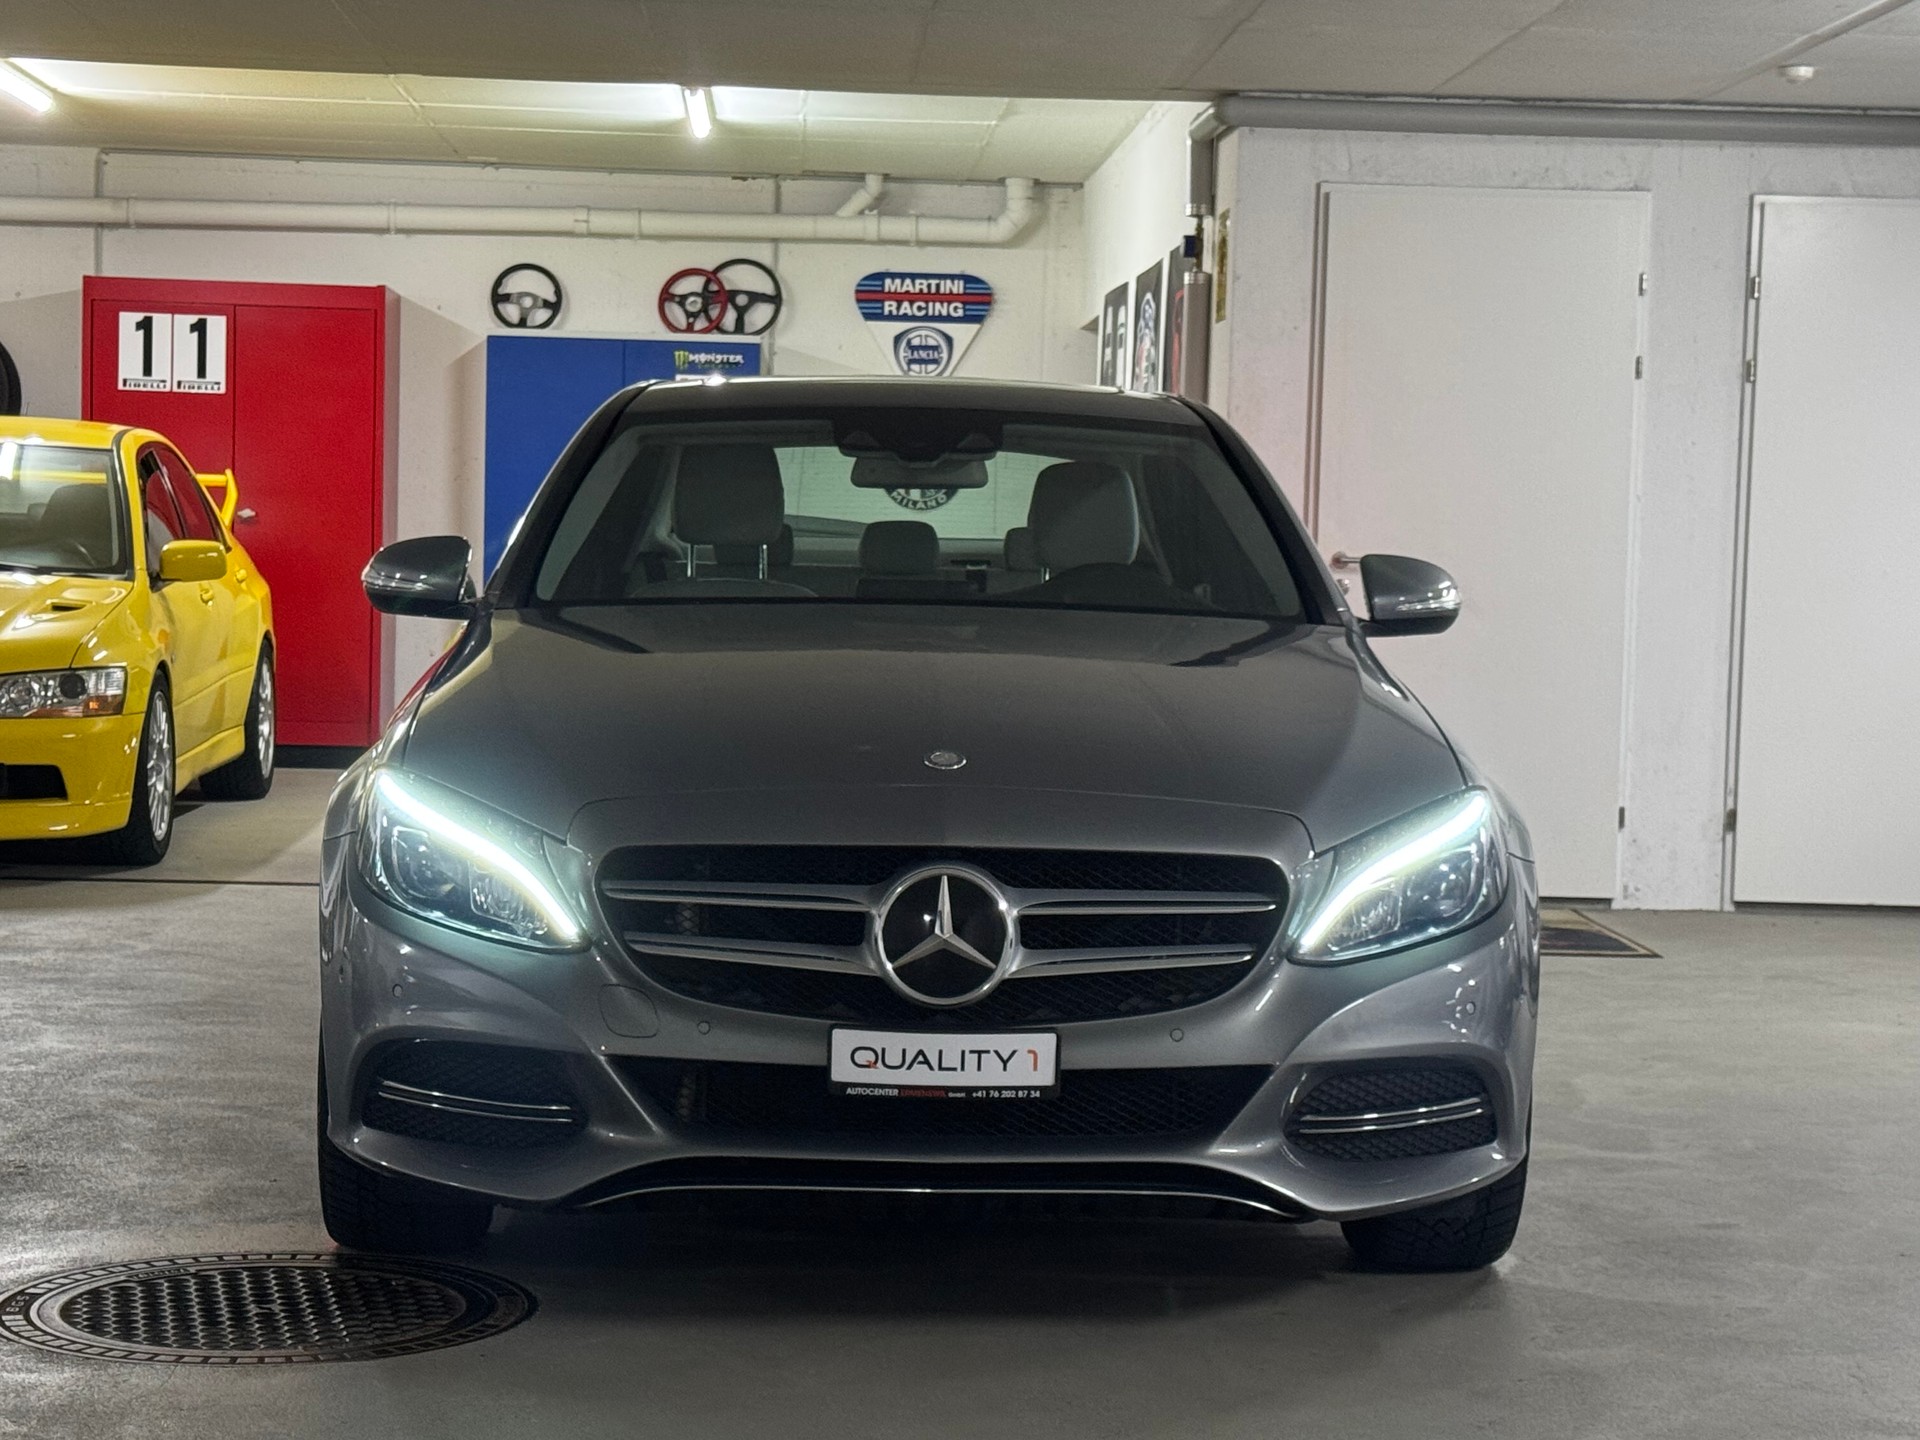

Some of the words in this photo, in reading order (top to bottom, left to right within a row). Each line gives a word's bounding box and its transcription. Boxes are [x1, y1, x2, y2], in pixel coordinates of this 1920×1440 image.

[884, 278, 964, 294] MARTINI
[883, 301, 964, 317] RACING
[689, 352, 744, 364] MONSTER
[908, 349, 939, 359] LANCIA
[890, 491, 947, 510] MILANO
[850, 1046, 1019, 1072] QUALITY
[1027, 1049, 1038, 1072] 1
[846, 1087, 899, 1096] AUTOCENTER
[973, 1090, 986, 1098] +41
[989, 1090, 1000, 1098] 76
[1001, 1090, 1016, 1098] 202
[1018, 1090, 1028, 1098] 87
[1030, 1090, 1041, 1098] 34
